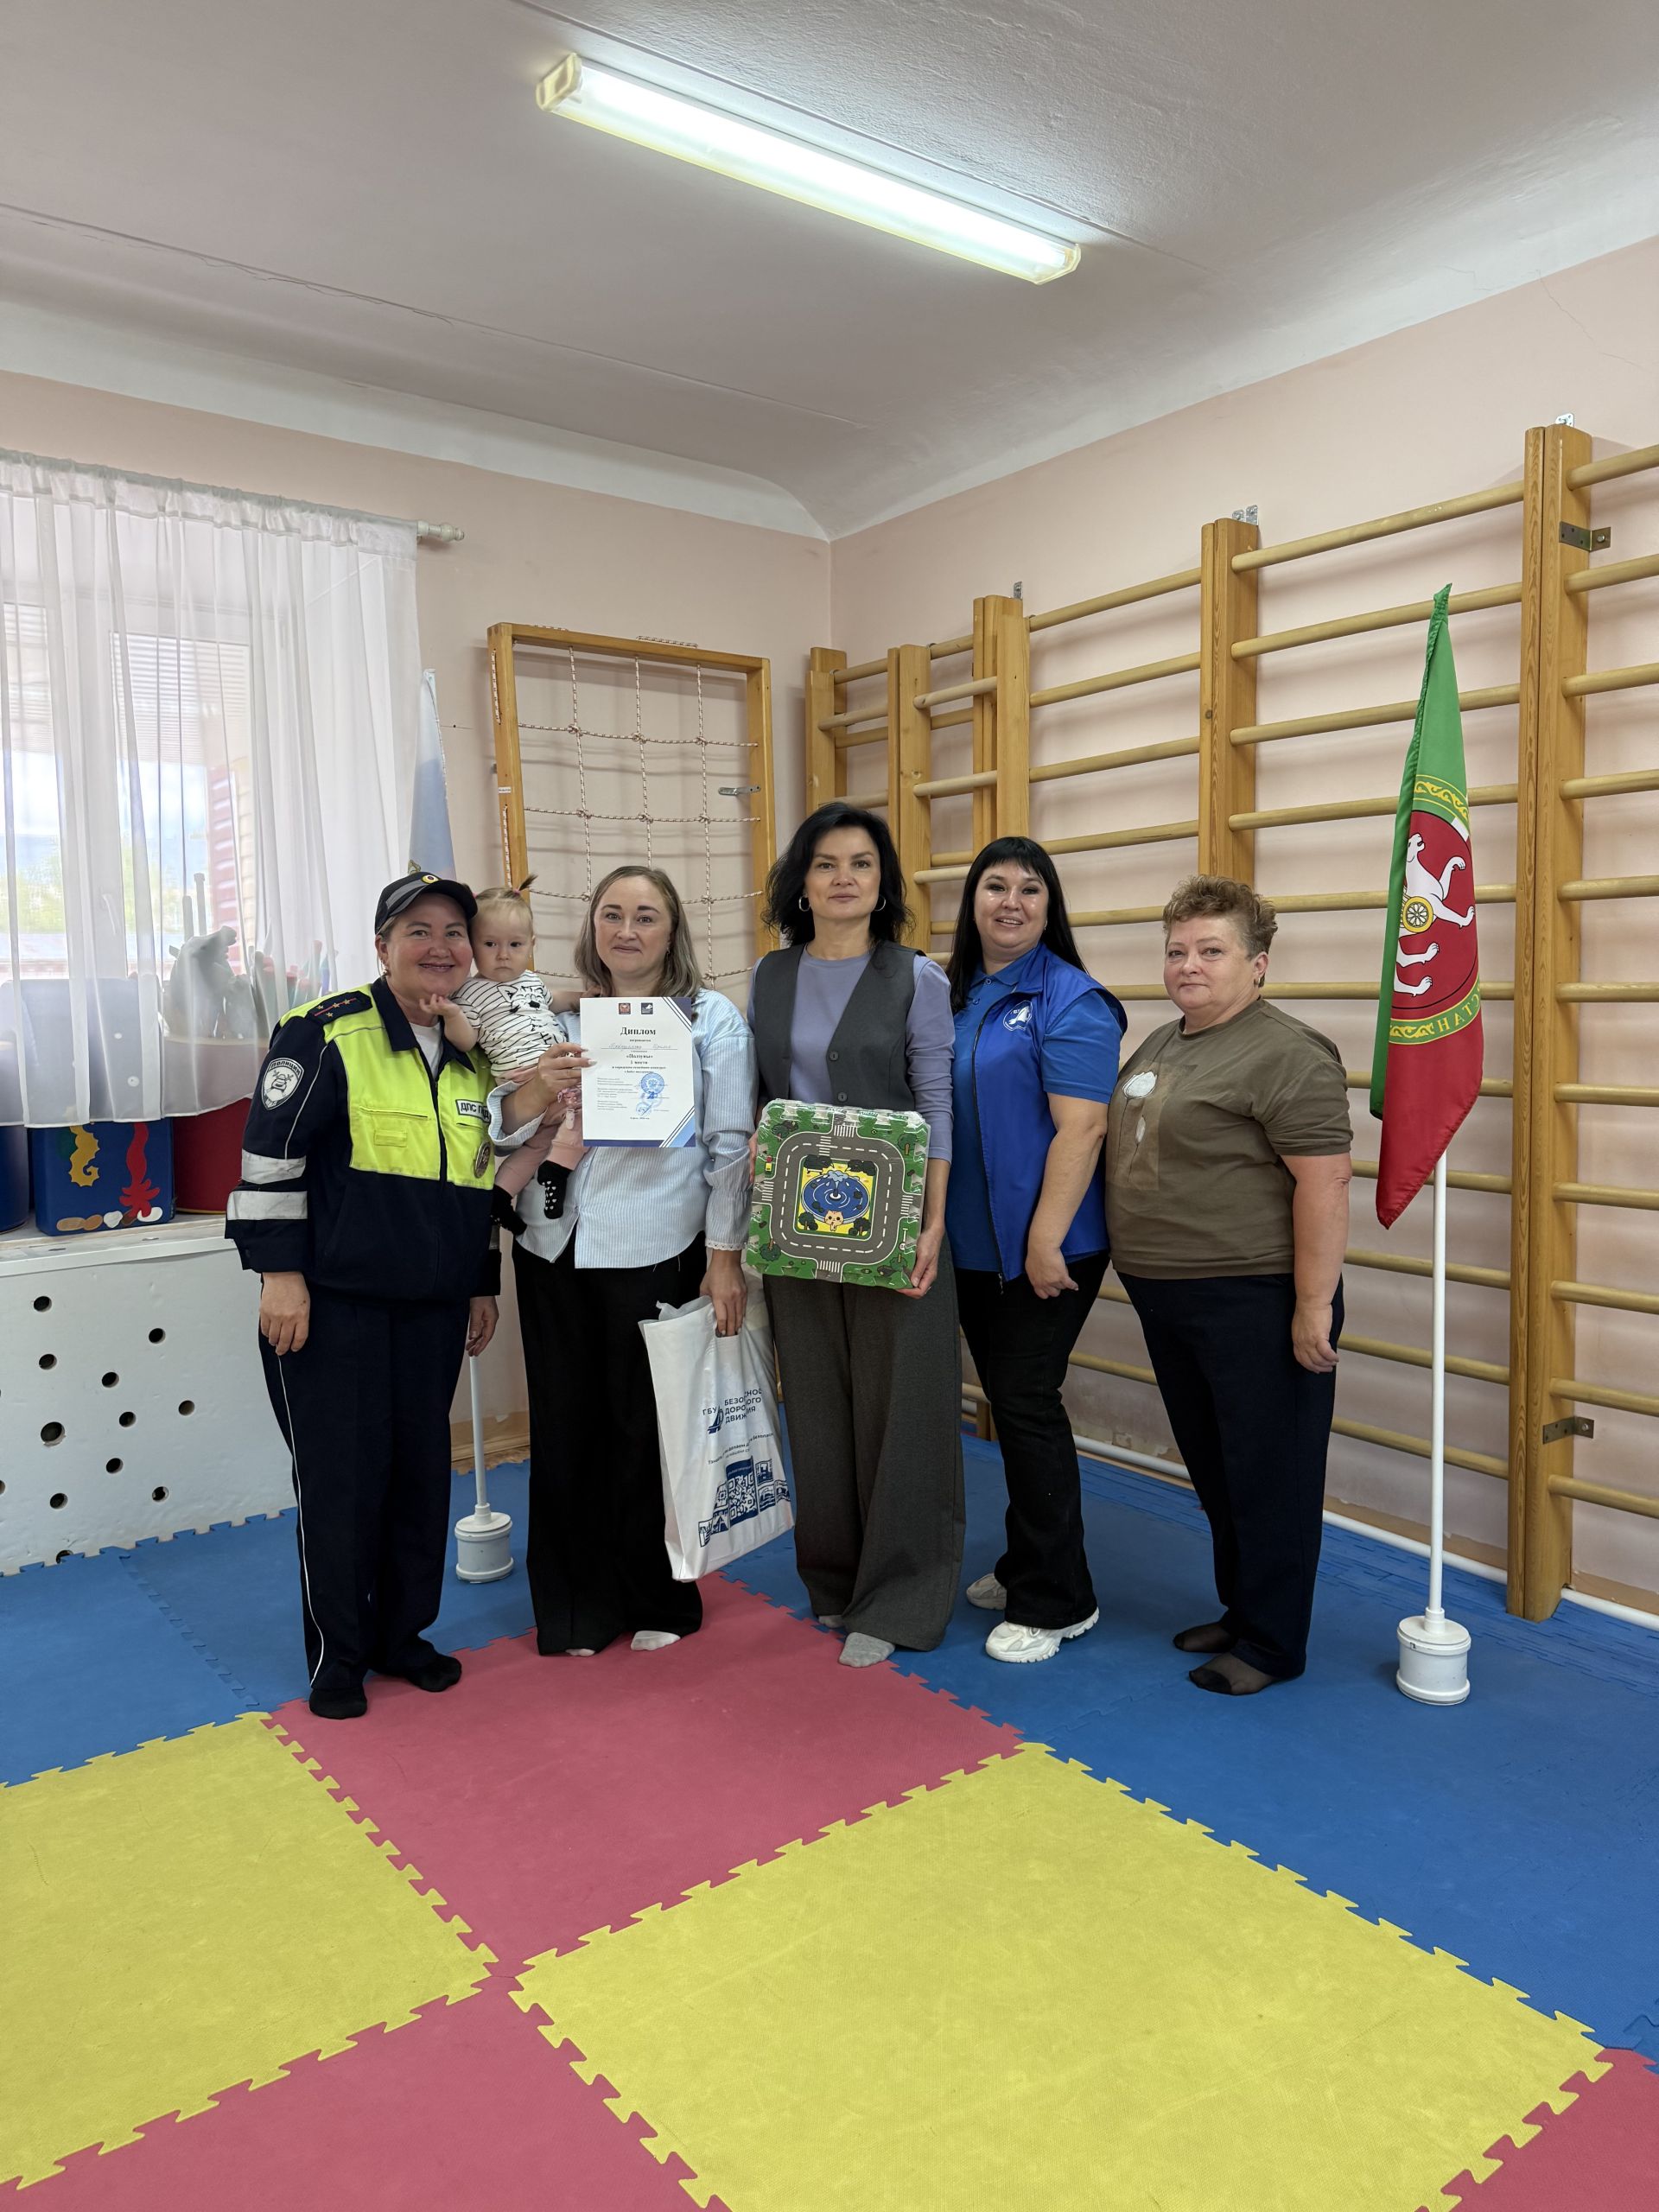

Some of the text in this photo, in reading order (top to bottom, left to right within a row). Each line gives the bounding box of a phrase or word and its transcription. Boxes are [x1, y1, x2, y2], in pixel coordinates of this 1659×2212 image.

[620, 1027, 656, 1036] Диплом
[270, 1060, 301, 1076] ПОЛИЦИЯ
[461, 1103, 476, 1113] ДПС
[702, 1407, 717, 1415] ГБУ
